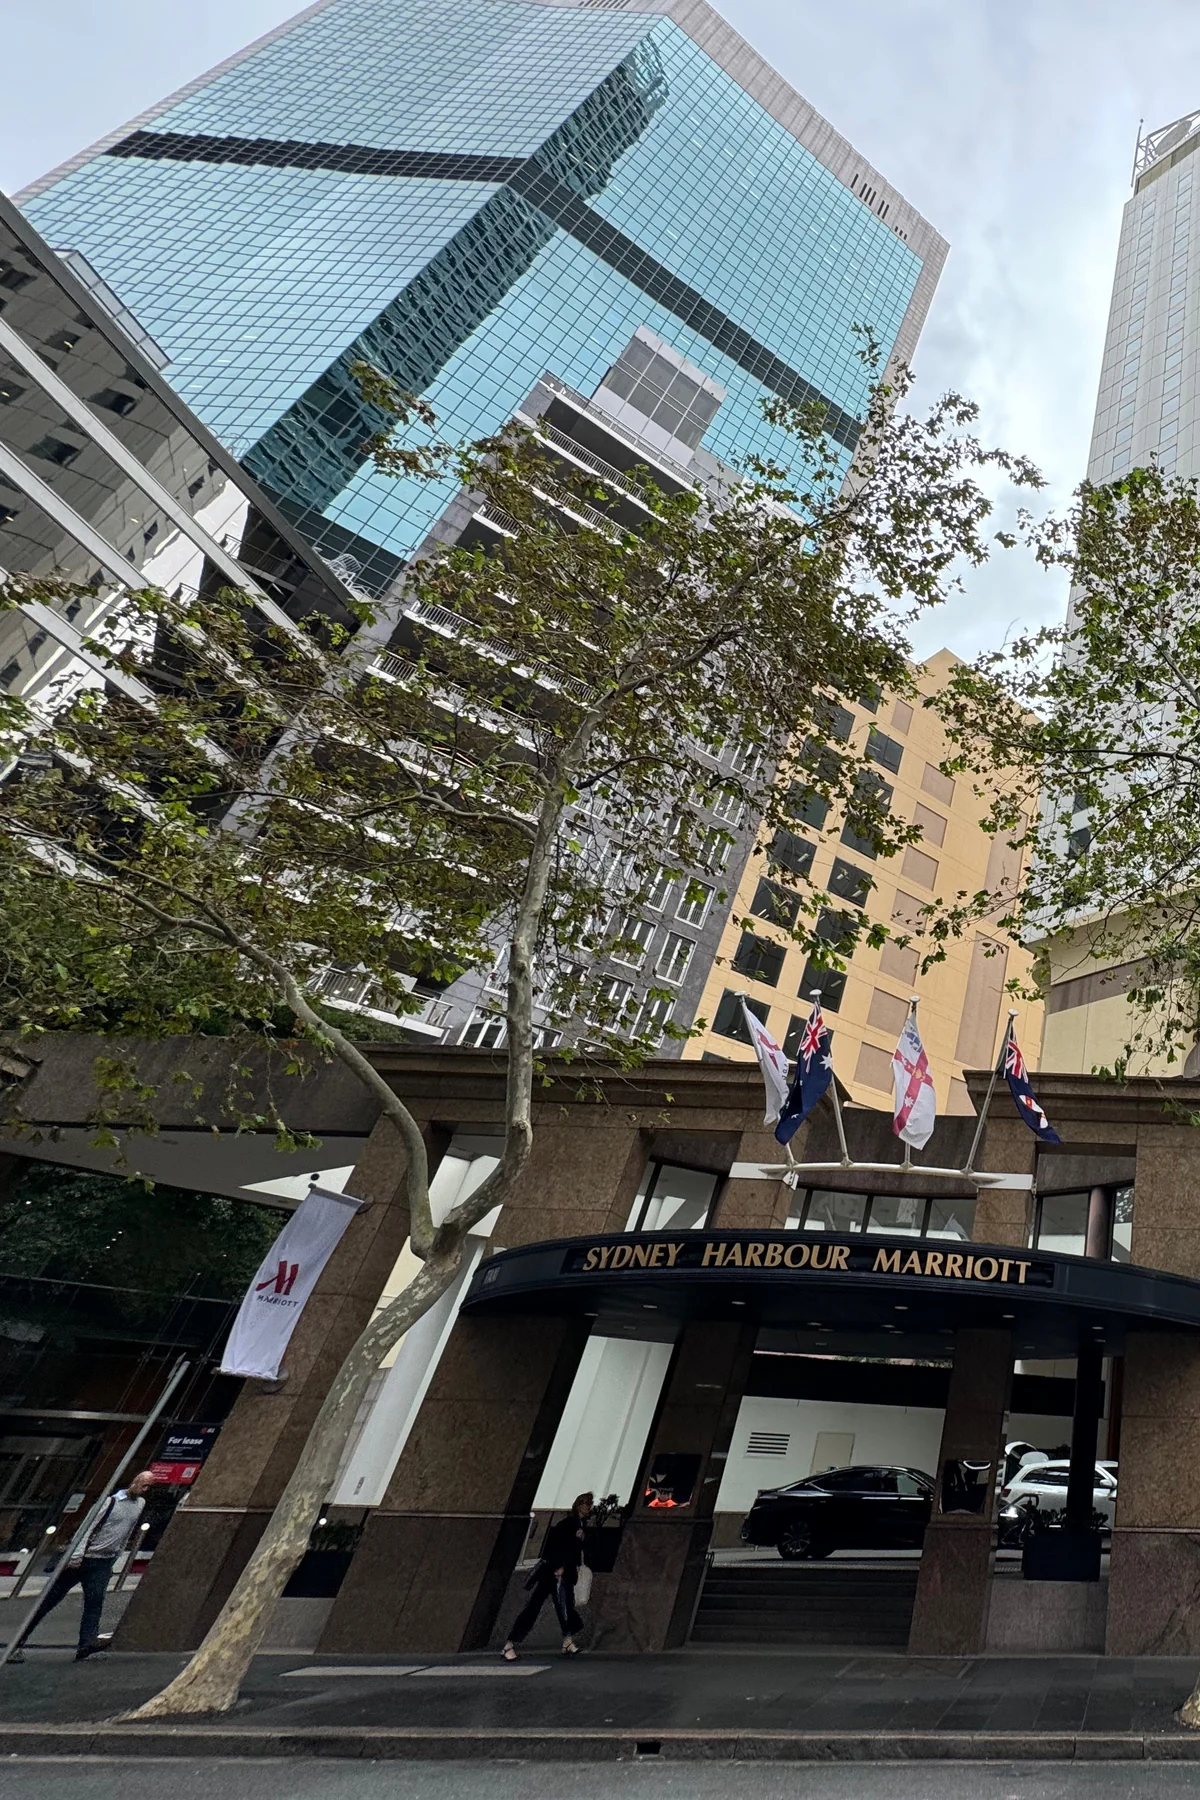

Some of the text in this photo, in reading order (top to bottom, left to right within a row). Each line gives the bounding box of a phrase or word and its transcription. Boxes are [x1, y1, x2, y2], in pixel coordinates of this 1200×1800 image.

[583, 1242, 1032, 1285] SYDNEY HARBOUR MARRIOTT
[256, 1294, 299, 1308] MARRIOTT
[182, 1437, 203, 1445] lease
